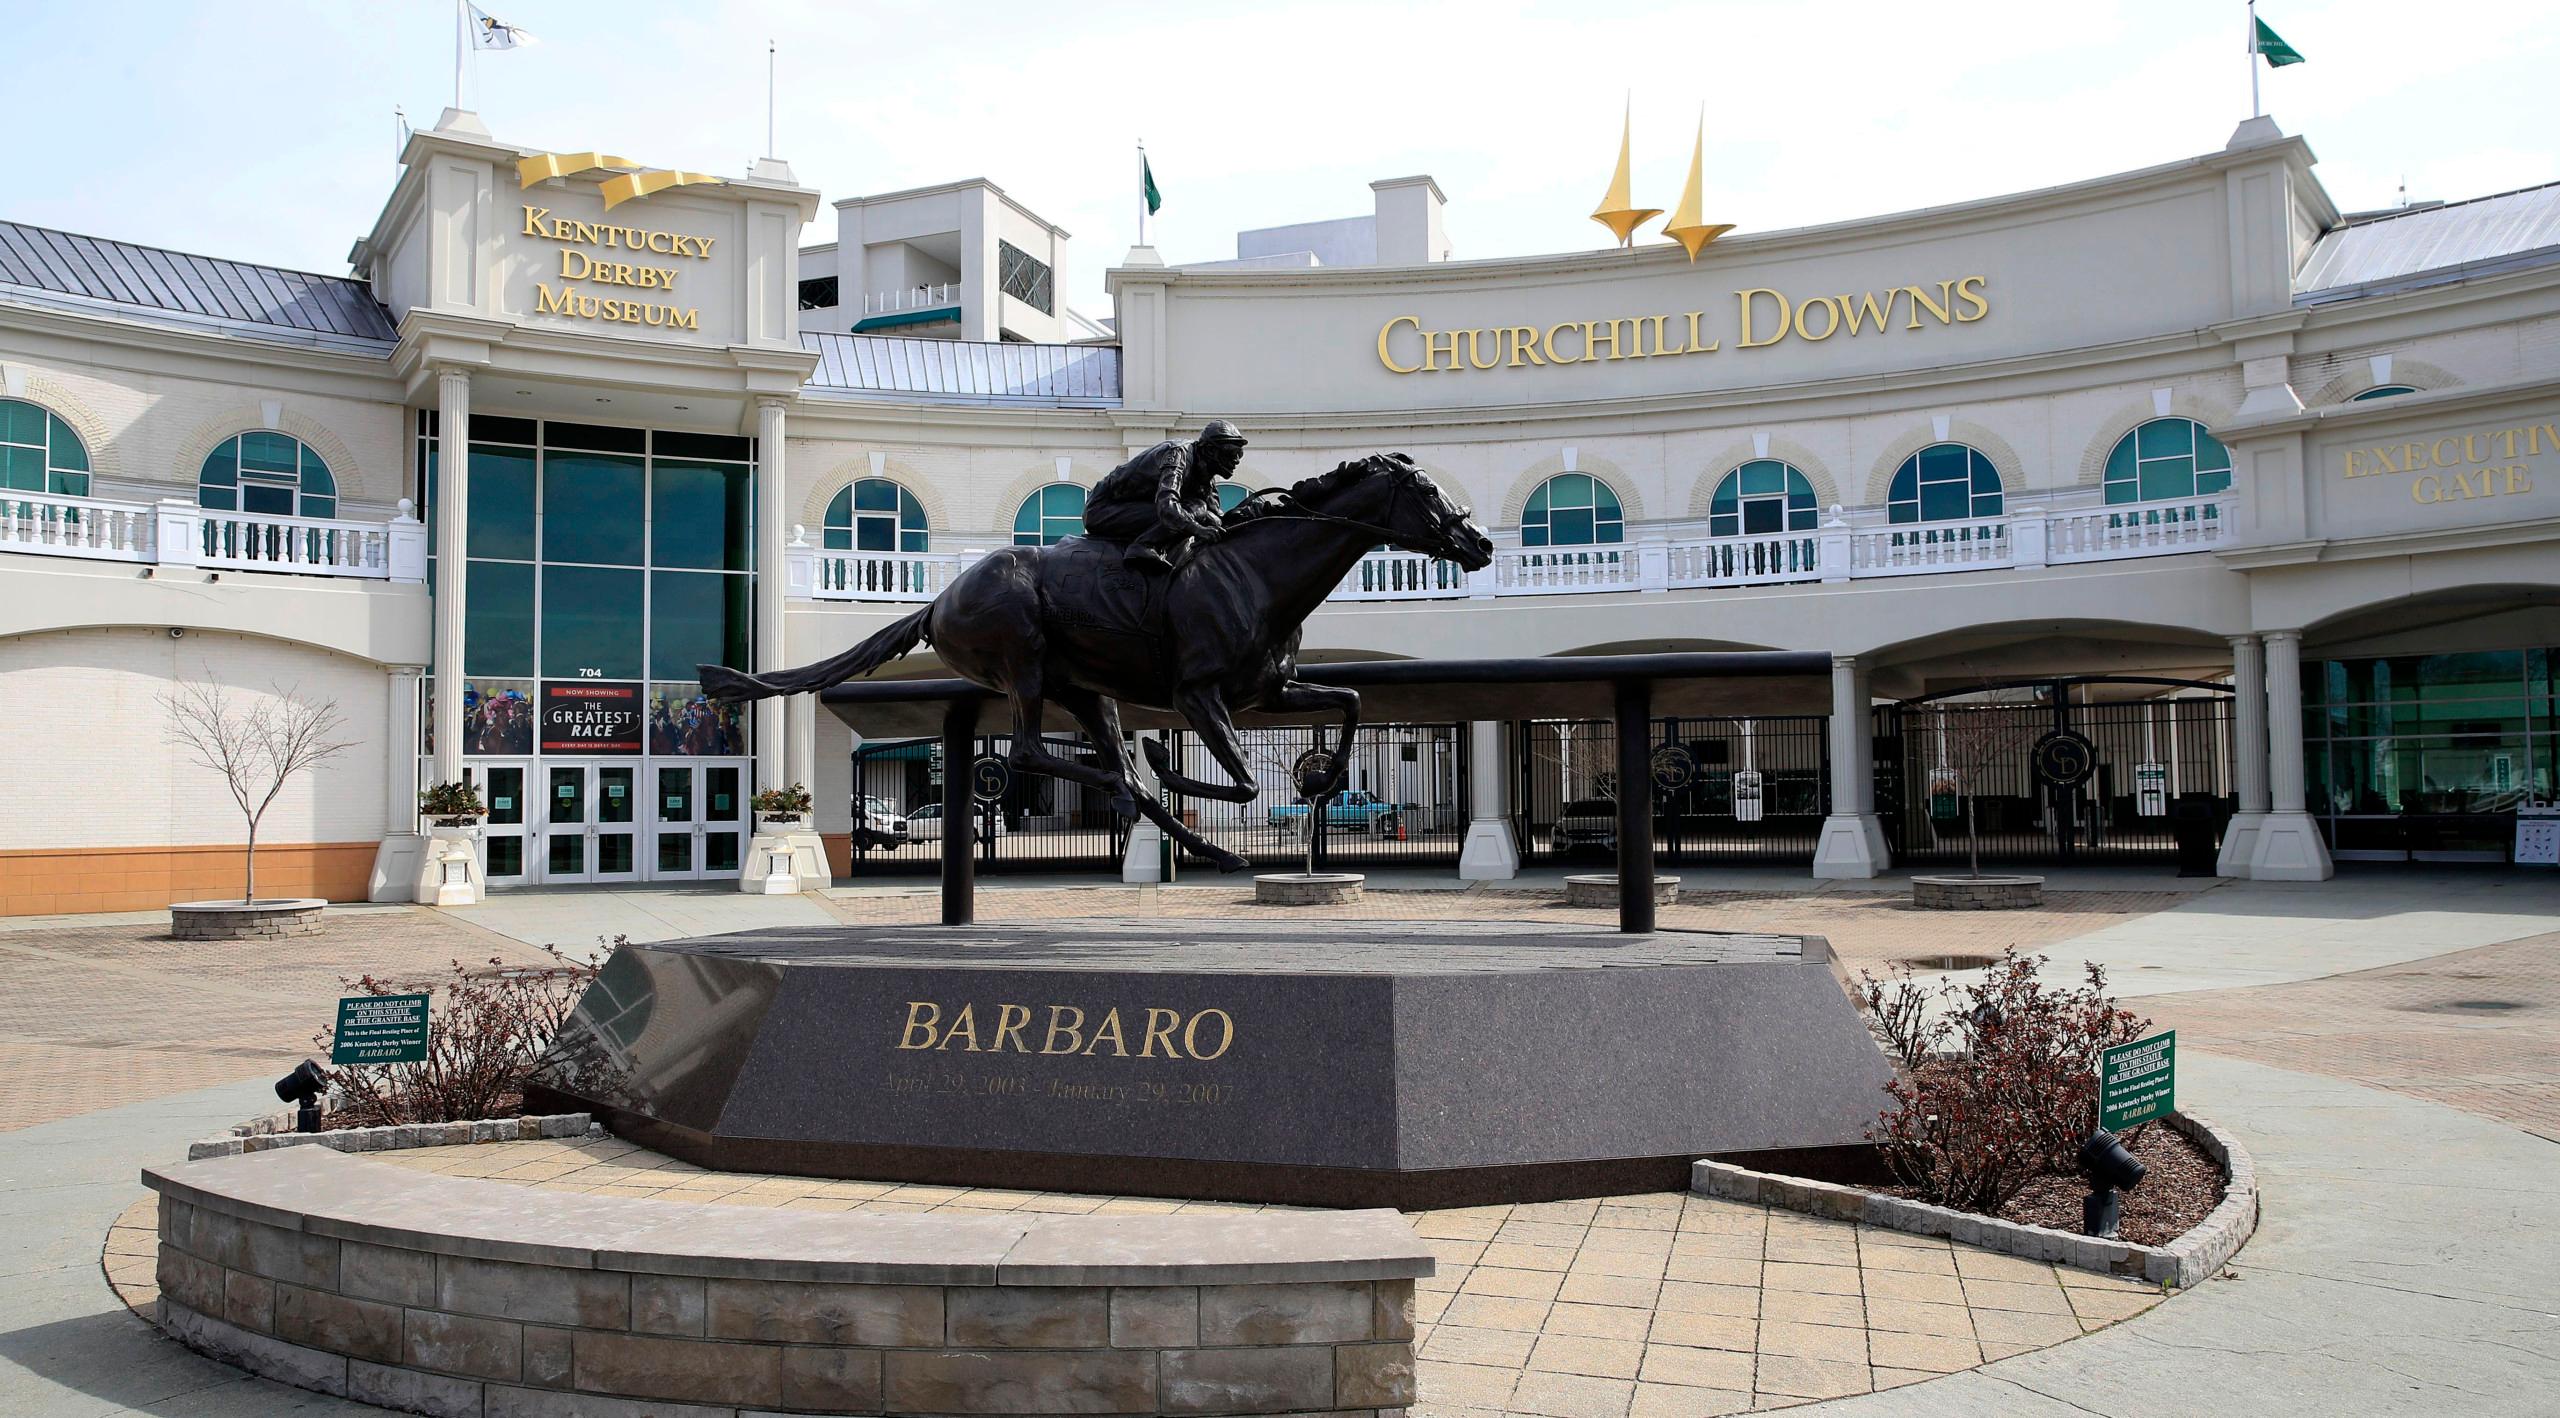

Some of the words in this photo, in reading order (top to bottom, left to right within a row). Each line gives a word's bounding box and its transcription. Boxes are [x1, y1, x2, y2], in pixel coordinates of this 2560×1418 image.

[521, 204, 716, 259] KENTUCKY
[559, 247, 679, 290] DERBY
[535, 282, 699, 330] MUSEUM
[1377, 312, 1720, 373] CHURCHILL
[1734, 275, 1989, 349] DOWNS
[2411, 463, 2533, 505] GATE
[579, 668, 602, 678] 704
[584, 702, 602, 711] THE
[553, 711, 632, 724] GREATEST
[571, 724, 614, 737] RACE
[346, 1002, 372, 1010] PLEASE
[384, 1000, 399, 1008] NOT
[399, 999, 422, 1007] CLIMB
[357, 1017, 370, 1025] THE
[371, 1016, 403, 1024] GRANITE
[382, 1028, 400, 1036] Resting
[894, 1001, 1235, 1062] BARBARO
[355, 1040, 381, 1048] Kentucky
[382, 1039, 400, 1047] Derby
[358, 1048, 402, 1057] BARBARO
[2109, 1050, 2132, 1064] PLEASE
[2132, 1047, 2142, 1056] DO
[2142, 1043, 2154, 1054] NOT
[2154, 1038, 2171, 1051] CLIMB
[2108, 1074, 2119, 1083] OR
[2119, 1070, 2131, 1080] THE
[2131, 1062, 2156, 1077] GRANITE
[2157, 1057, 2170, 1069] BASE
[2118, 1062, 2128, 1070] ON
[2129, 1057, 2142, 1068] THIS
[2142, 1051, 2163, 1064] STATUE
[2109, 1089, 2118, 1098] This
[2118, 1097, 2140, 1109] Kentucky
[2141, 1092, 2154, 1103] Derby
[2155, 1087, 2171, 1098] Winner
[2122, 1102, 2157, 1121] BARBARO
